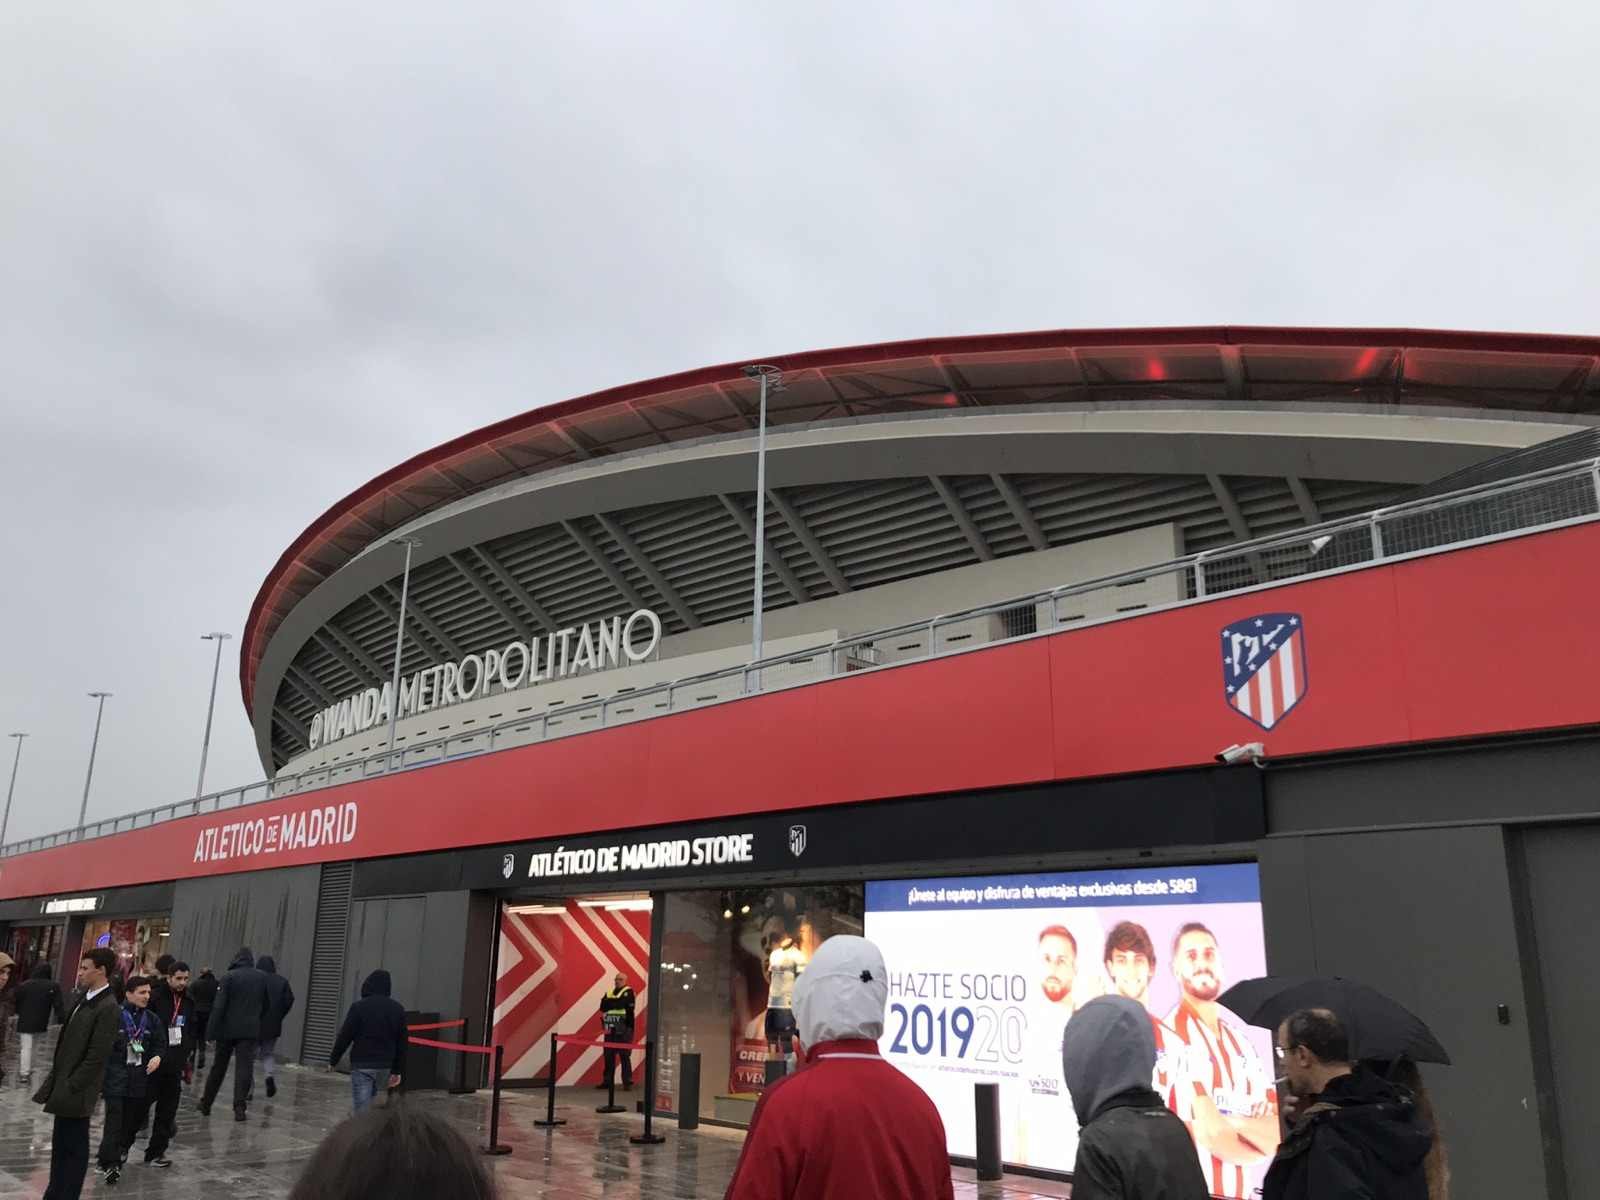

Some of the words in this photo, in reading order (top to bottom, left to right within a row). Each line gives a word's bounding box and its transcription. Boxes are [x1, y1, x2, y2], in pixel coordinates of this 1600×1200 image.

[323, 682, 395, 745] WANDA
[399, 608, 662, 719] METROPOLITANO
[193, 818, 265, 863] ATLETICO
[266, 824, 279, 844] DE
[279, 802, 358, 850] MADRID
[528, 846, 595, 877] ATLÉTICO
[596, 847, 619, 872] DE
[621, 840, 690, 870] MADRID
[691, 833, 754, 865] STORE
[946, 888, 976, 903] equipo
[976, 889, 983, 903] y
[1021, 885, 1034, 899] de
[1035, 884, 1077, 901] ventajas
[1079, 881, 1132, 897] exclusivas
[1133, 880, 1168, 895] desde
[890, 972, 953, 999] HAZTE
[960, 974, 1026, 1001] SOCIO
